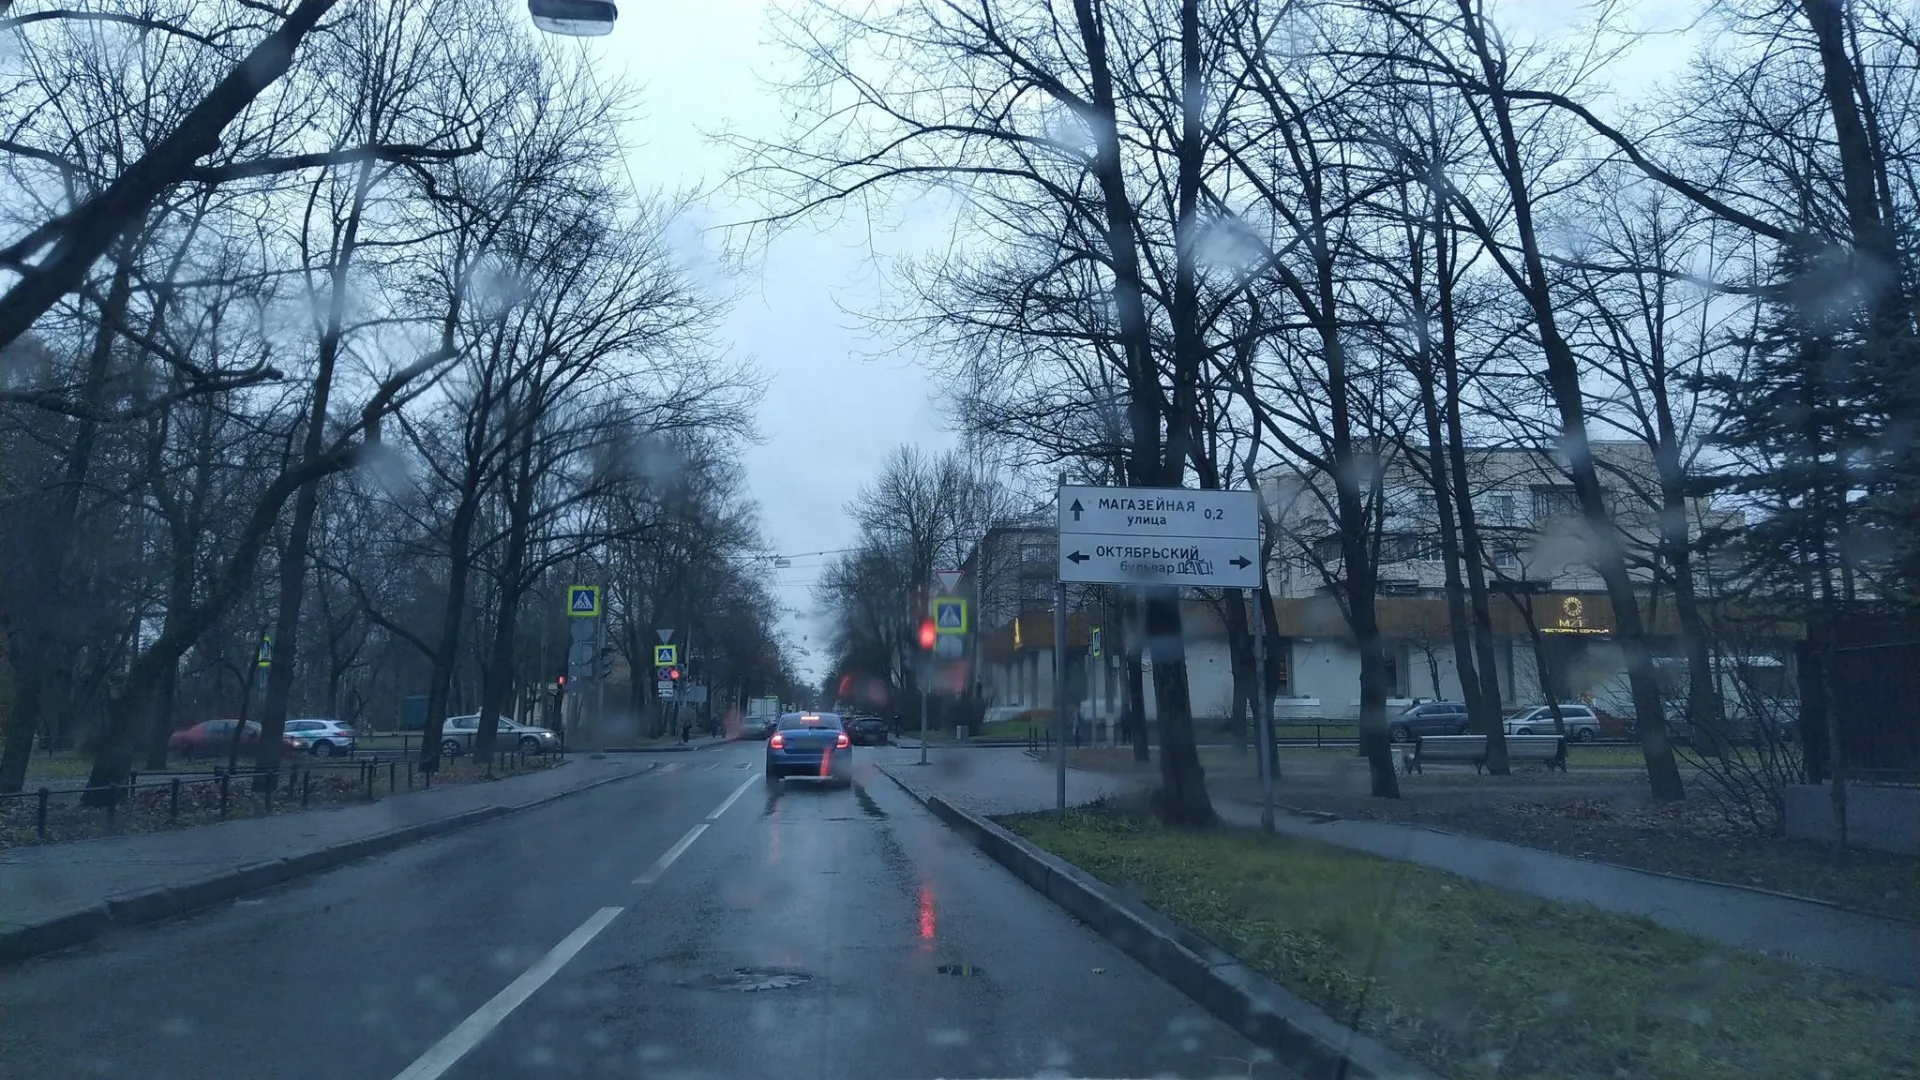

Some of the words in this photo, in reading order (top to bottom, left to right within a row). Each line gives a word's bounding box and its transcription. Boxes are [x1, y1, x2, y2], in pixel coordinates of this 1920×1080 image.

[1098, 497, 1195, 512] МАГАЗЕЙНАЯ
[1127, 514, 1167, 527] улица
[1096, 545, 1199, 560] ОКТЯБРЬСКИЙ
[1120, 561, 1175, 576] бульвар
